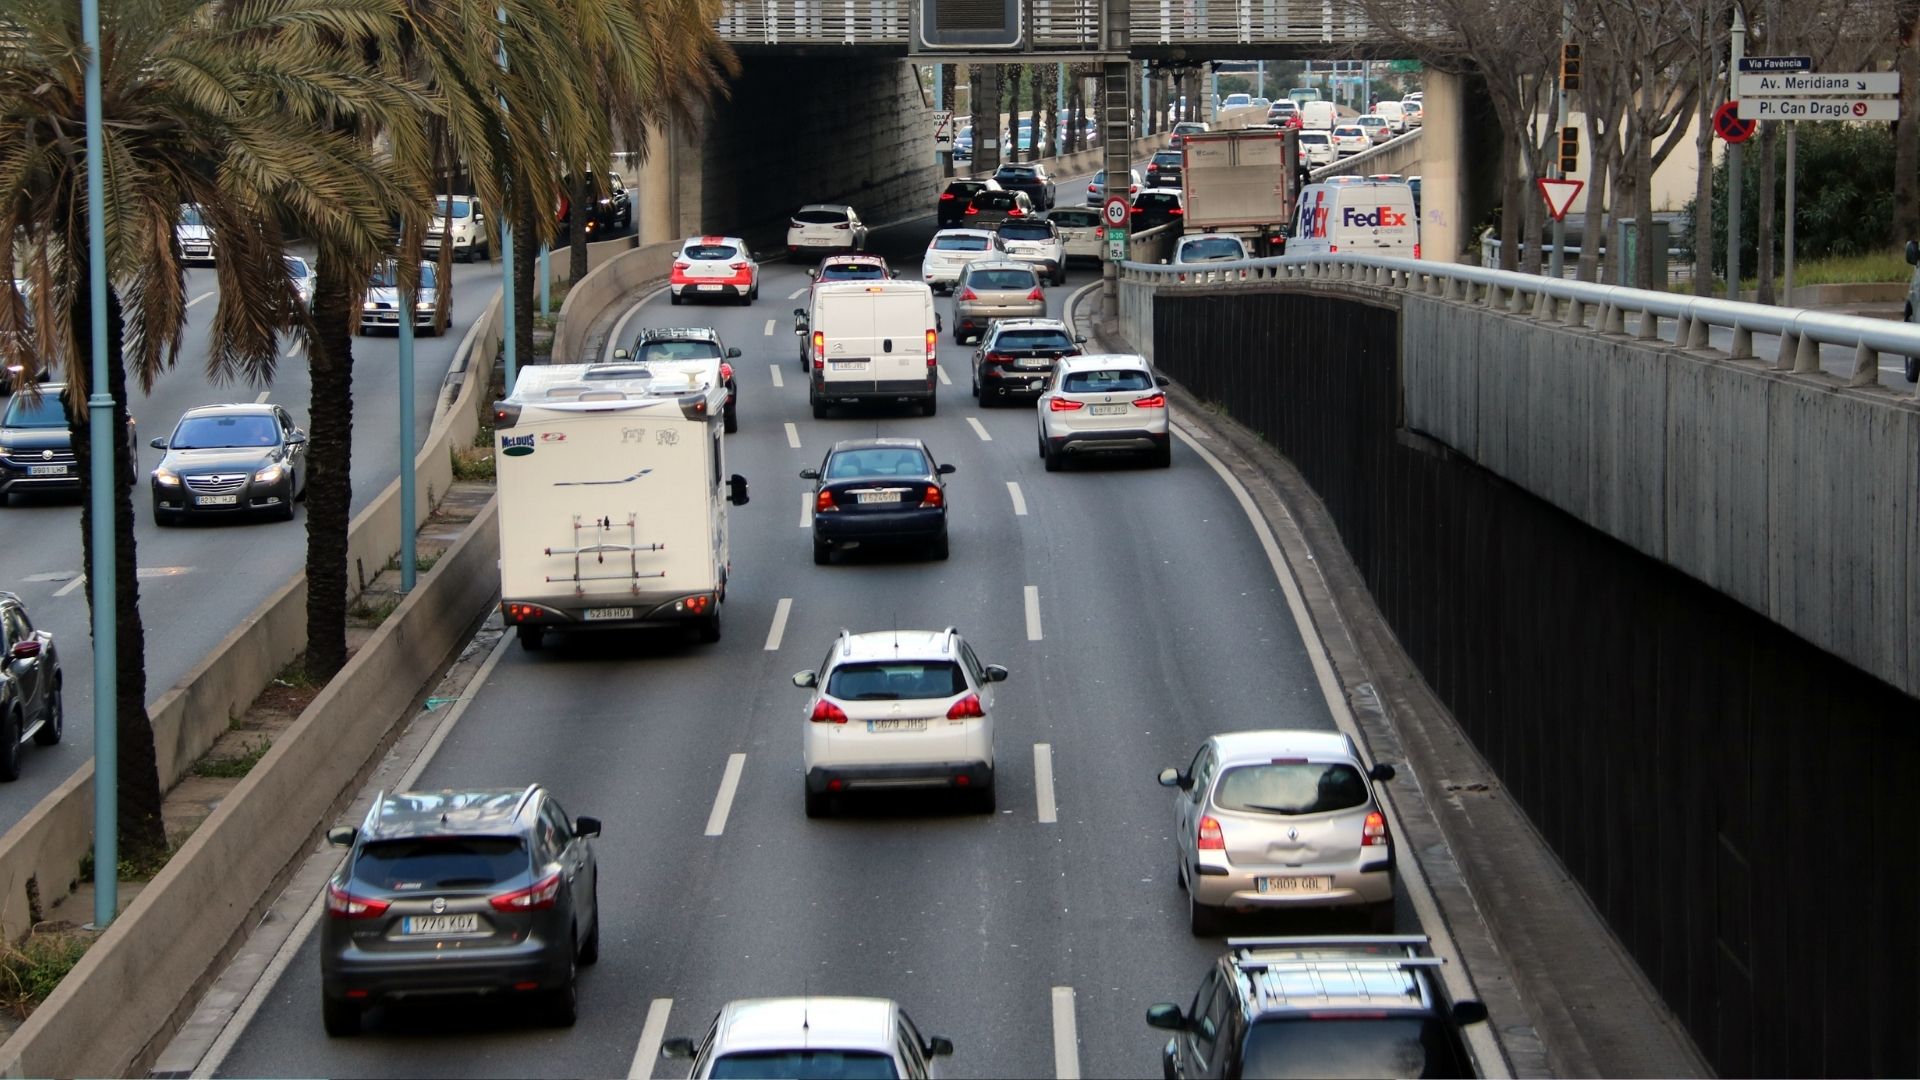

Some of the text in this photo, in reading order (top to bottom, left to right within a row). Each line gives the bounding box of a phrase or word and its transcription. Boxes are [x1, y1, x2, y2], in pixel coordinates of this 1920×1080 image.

[1749, 58, 1802, 68] Via Favència
[1760, 77, 1849, 90] Av. Meridiana
[1760, 102, 1849, 117] Pl. Can Dragó
[1109, 206, 1123, 217] 60
[1300, 191, 1330, 240] FedEx
[1343, 206, 1407, 227] FedEx
[200, 496, 217, 504] 8232
[1269, 878, 1297, 889] 5809
[415, 916, 445, 932] 1770
